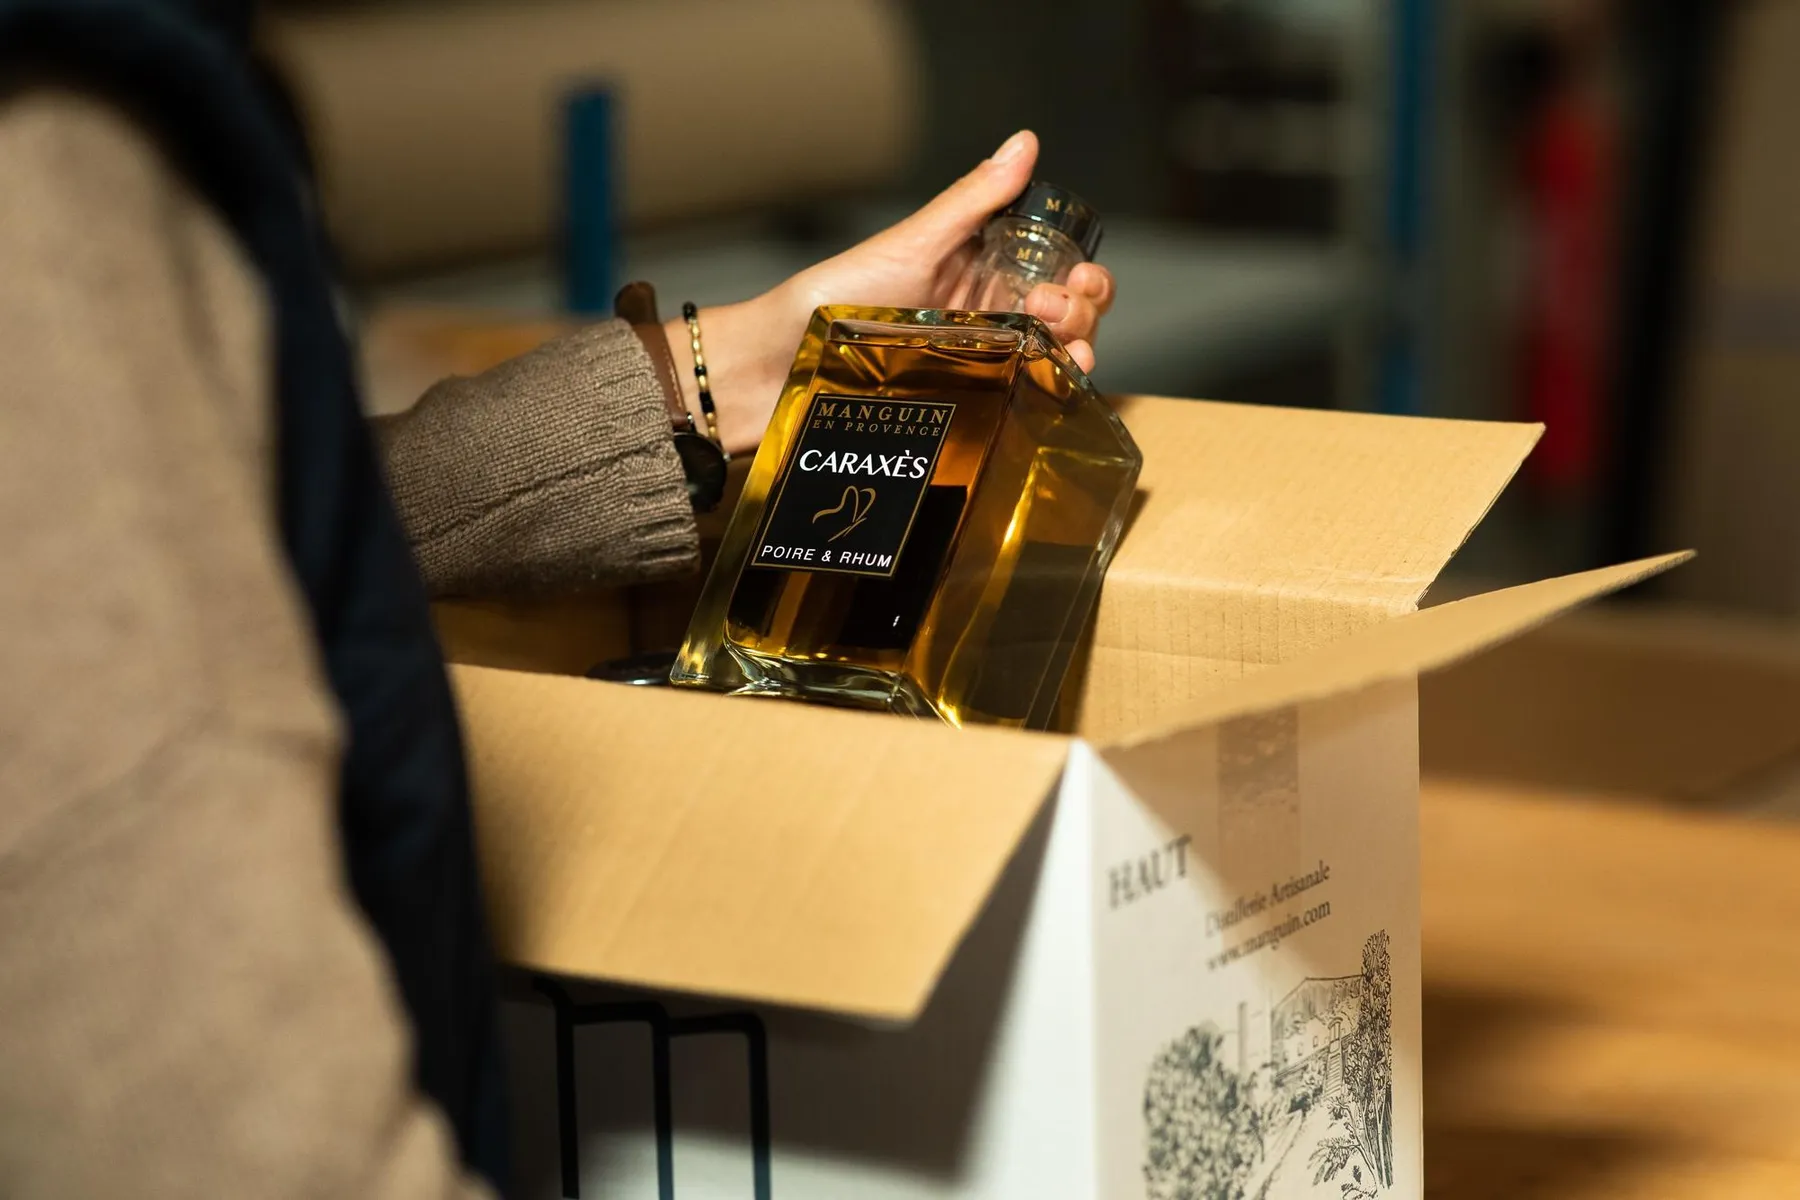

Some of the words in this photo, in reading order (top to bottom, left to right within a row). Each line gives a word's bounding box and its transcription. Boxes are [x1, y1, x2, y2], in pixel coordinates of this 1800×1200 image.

[812, 419, 836, 431] EN
[844, 422, 942, 437] PROVENCE
[817, 402, 949, 425] MANGUIN
[799, 449, 929, 480] CARAXÈS
[761, 545, 817, 562] POIRE
[821, 550, 832, 563] &
[838, 551, 893, 568] RHUM
[1107, 833, 1193, 910] HAUT
[1269, 860, 1331, 906] Artisanale
[1206, 901, 1332, 972] www.manguin.com
